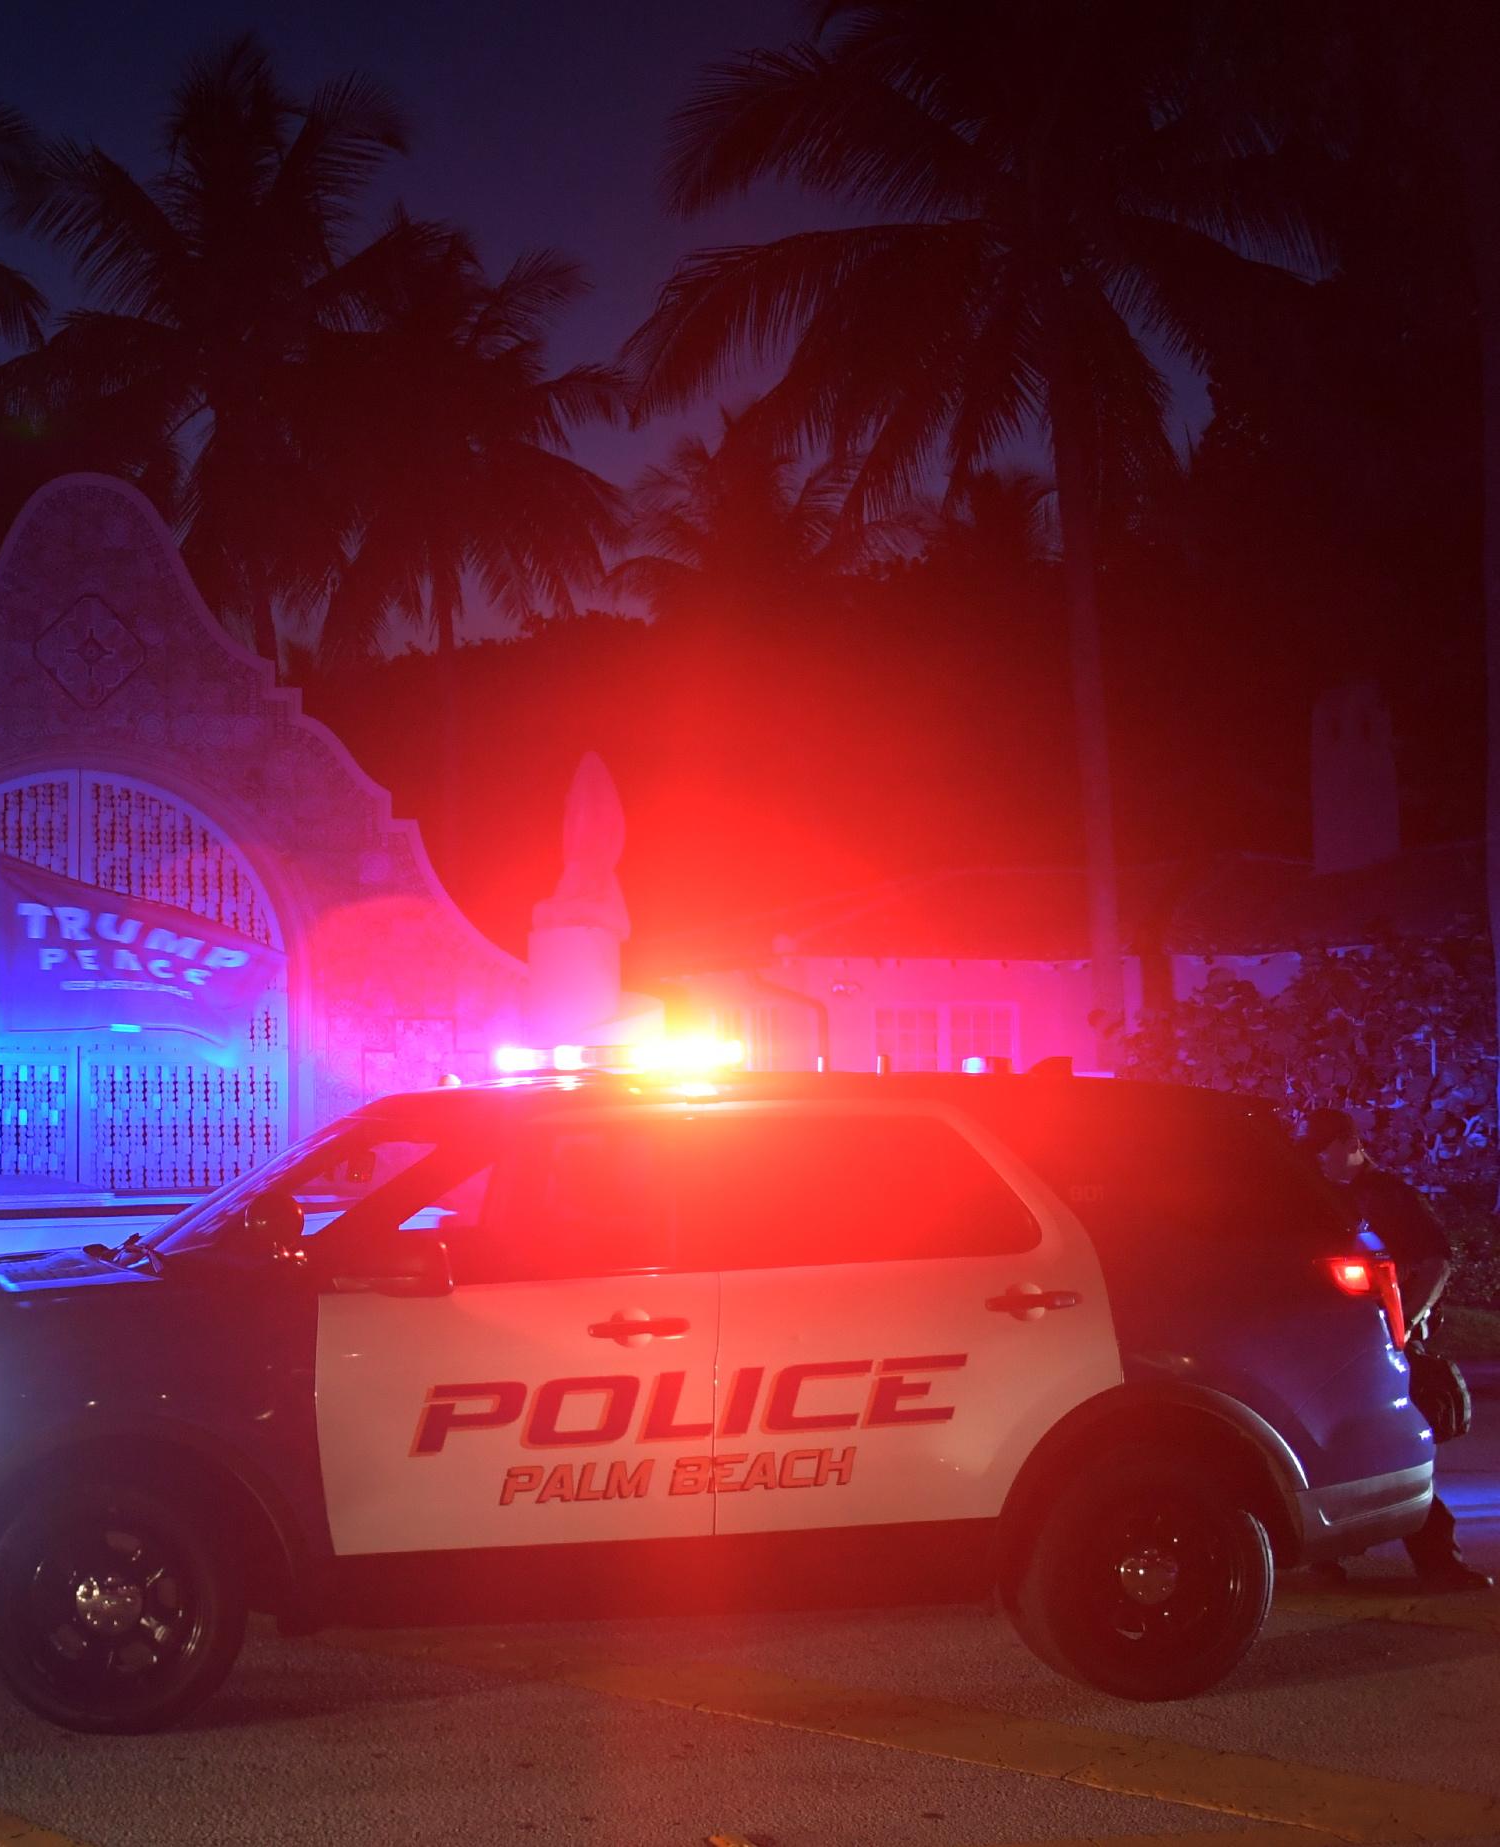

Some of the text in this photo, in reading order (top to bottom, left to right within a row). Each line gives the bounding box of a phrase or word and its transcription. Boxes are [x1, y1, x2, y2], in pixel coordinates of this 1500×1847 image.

[17, 902, 250, 968] TRUMP
[38, 947, 213, 985] PEACE
[409, 1353, 969, 1457] POLICE
[499, 1446, 856, 1506] PALM BEACH
